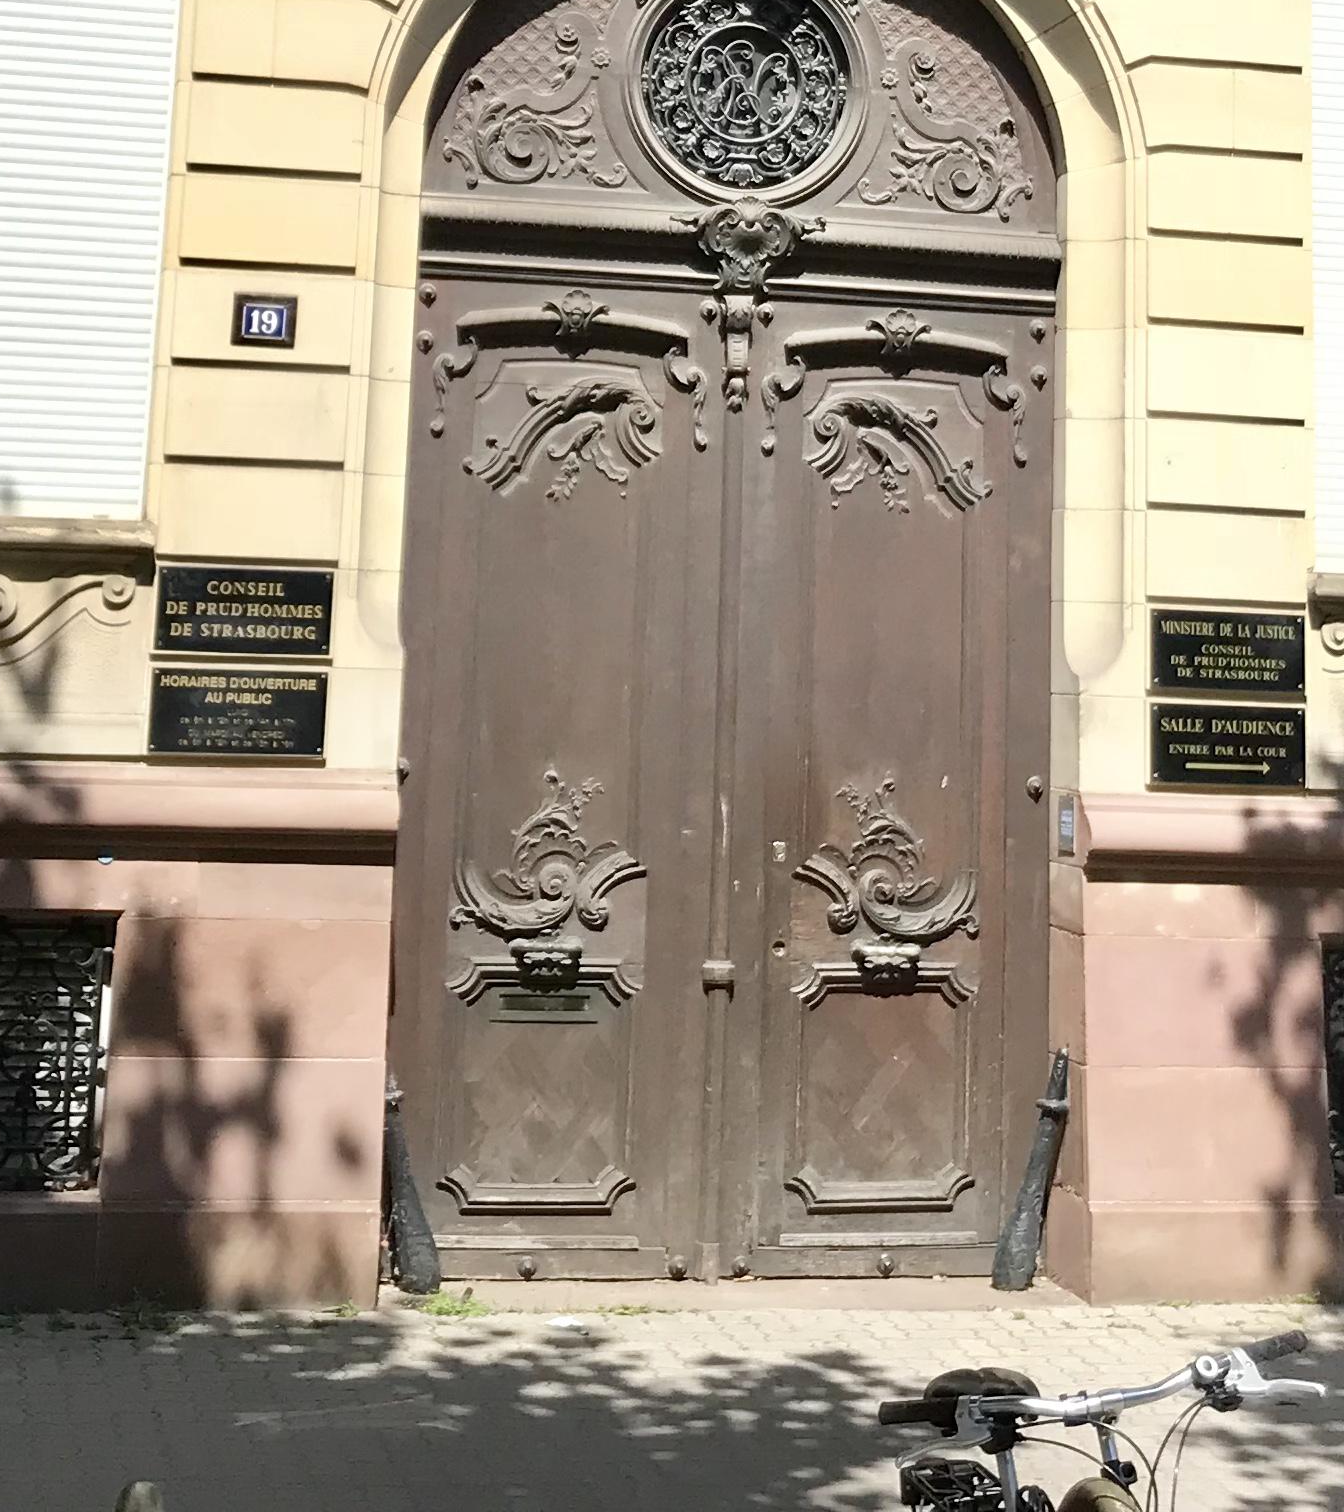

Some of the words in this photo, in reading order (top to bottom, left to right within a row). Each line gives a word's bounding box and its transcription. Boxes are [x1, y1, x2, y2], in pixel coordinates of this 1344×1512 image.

[248, 309, 277, 334] 19
[206, 581, 284, 596] CONSEIL
[166, 601, 188, 614] DE
[196, 602, 322, 618] PRUD'HOMMES
[170, 623, 192, 636] DE
[200, 624, 316, 640] STRASBOURG
[1220, 624, 1232, 636] DE
[1238, 626, 1250, 638] LA
[1254, 627, 1296, 640] JUSTICE
[1202, 645, 1254, 656] CONSEIL
[1170, 655, 1186, 666] DE
[1194, 656, 1286, 670] PRUD'HOMMES
[160, 675, 226, 688] HORAIRES
[230, 677, 316, 690] D'OUVERTURE
[1178, 668, 1192, 678] DE
[1200, 669, 1280, 682] STRASBOURG
[204, 692, 222, 704] AU
[226, 693, 272, 704] PUBLIC
[1160, 718, 1204, 732] SALLE
[1212, 720, 1294, 736] D'AUDIENCE
[1214, 745, 1234, 756] PAR
[1240, 746, 1252, 756] LA
[1258, 747, 1286, 758] COUR
